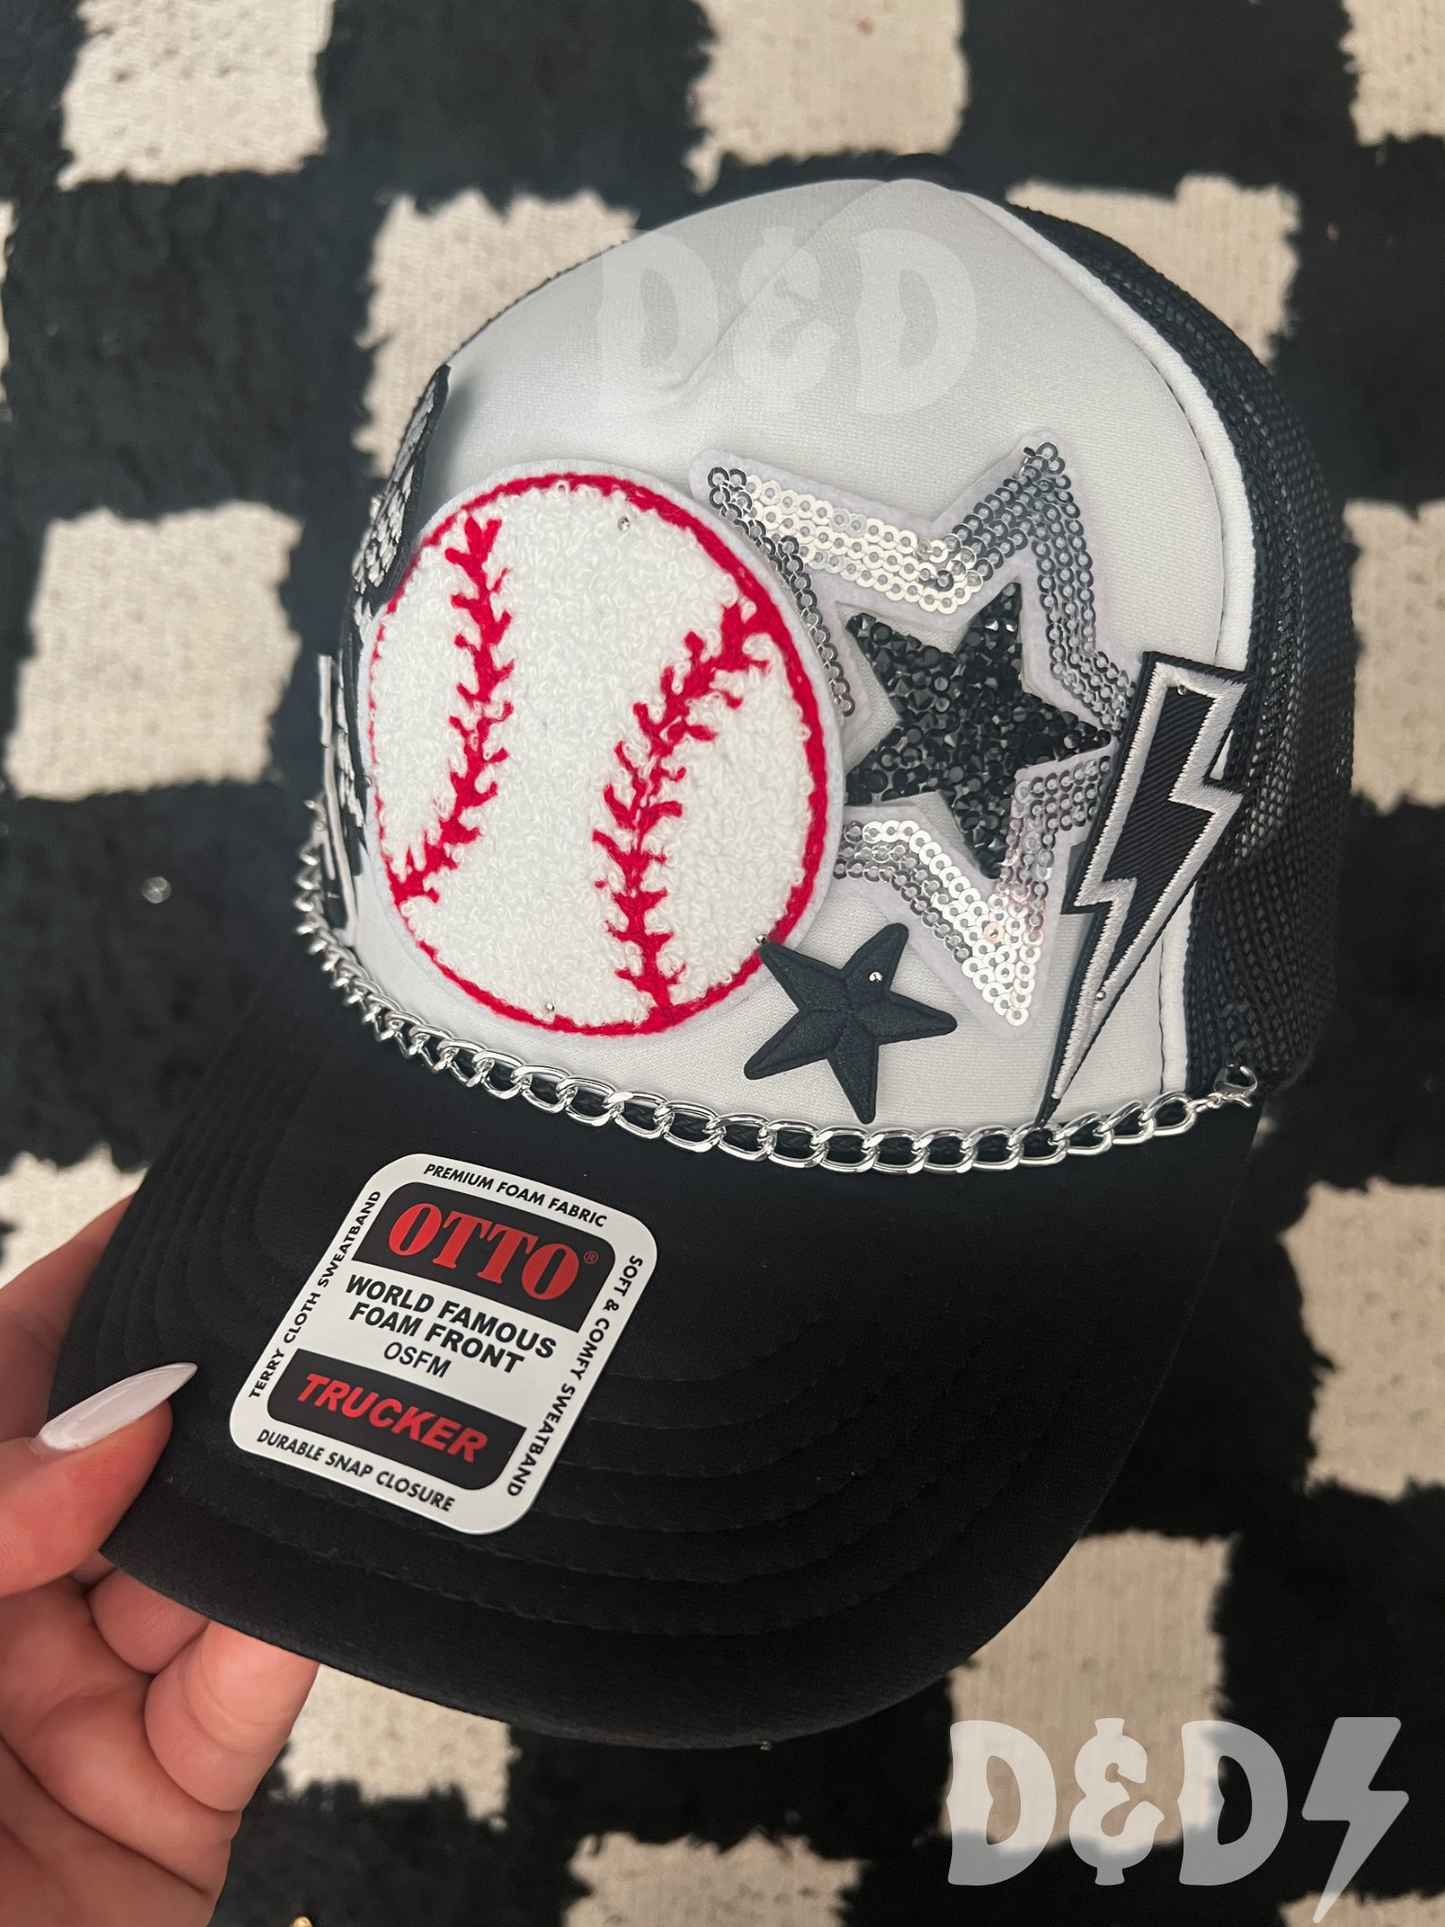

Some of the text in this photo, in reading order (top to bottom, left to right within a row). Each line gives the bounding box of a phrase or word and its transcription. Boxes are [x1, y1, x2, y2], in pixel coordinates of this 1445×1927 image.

[424, 1163, 607, 1228] PREMIUM FOAM FABRIC
[249, 1191, 381, 1398] TERRY CLOTH SWEATBAND
[345, 1275, 557, 1359] WORLD FAMOUS
[349, 1303, 525, 1374] FOAM FRONT
[383, 1342, 451, 1378] OSFM
[507, 1255, 643, 1496] SOFT & COMFY SWEATBAND
[297, 1374, 488, 1463] TRUCKER
[257, 1429, 455, 1512] DURABLE SNAP CLOSURE
